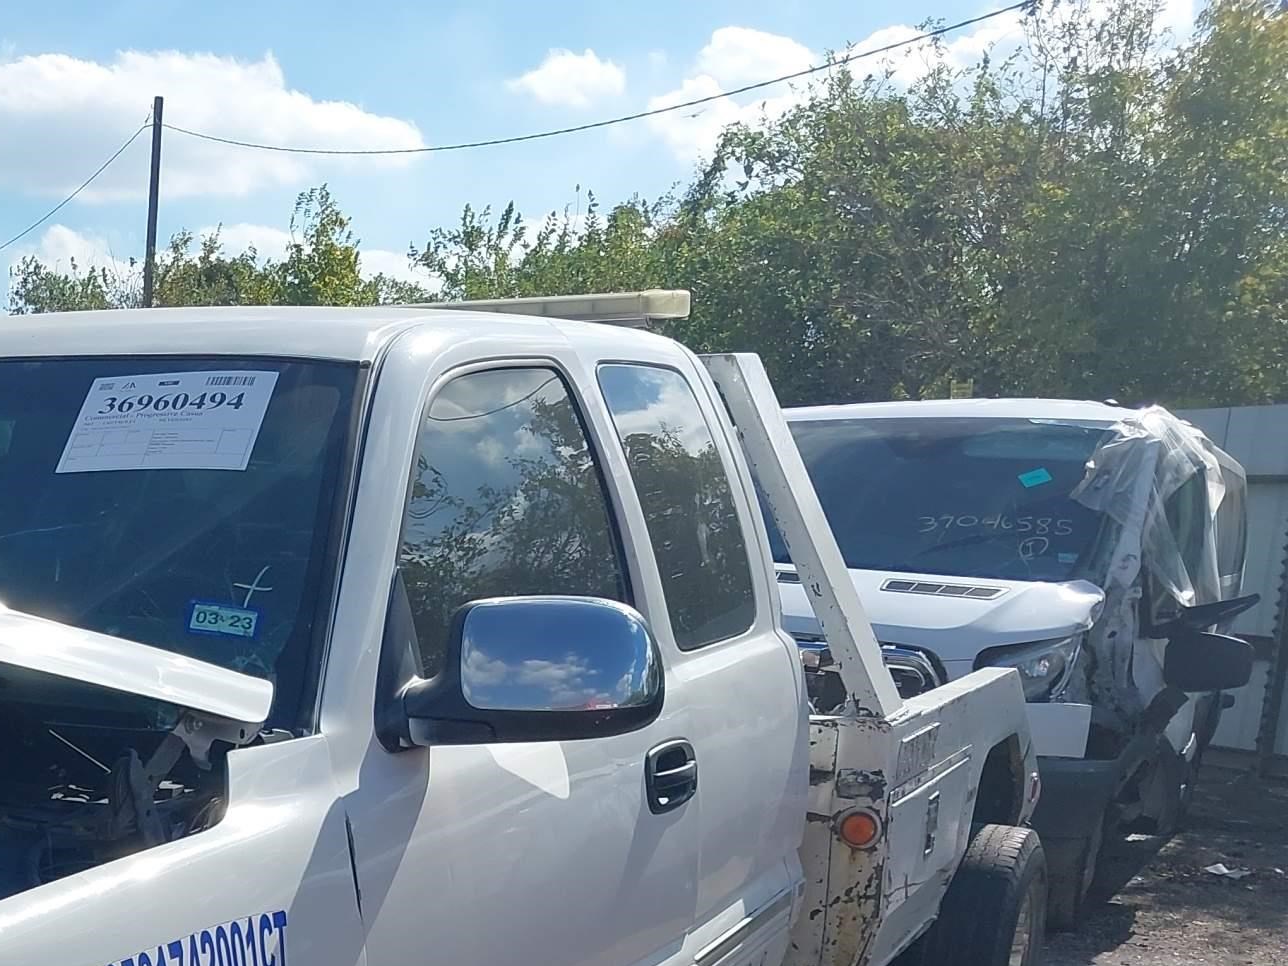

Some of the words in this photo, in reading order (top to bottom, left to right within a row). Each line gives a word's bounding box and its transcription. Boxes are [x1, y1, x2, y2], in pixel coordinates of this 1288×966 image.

[98, 391, 246, 415] 36960494
[918, 513, 1073, 536] 37046585
[195, 611, 219, 625] 03
[228, 615, 253, 630] 23
